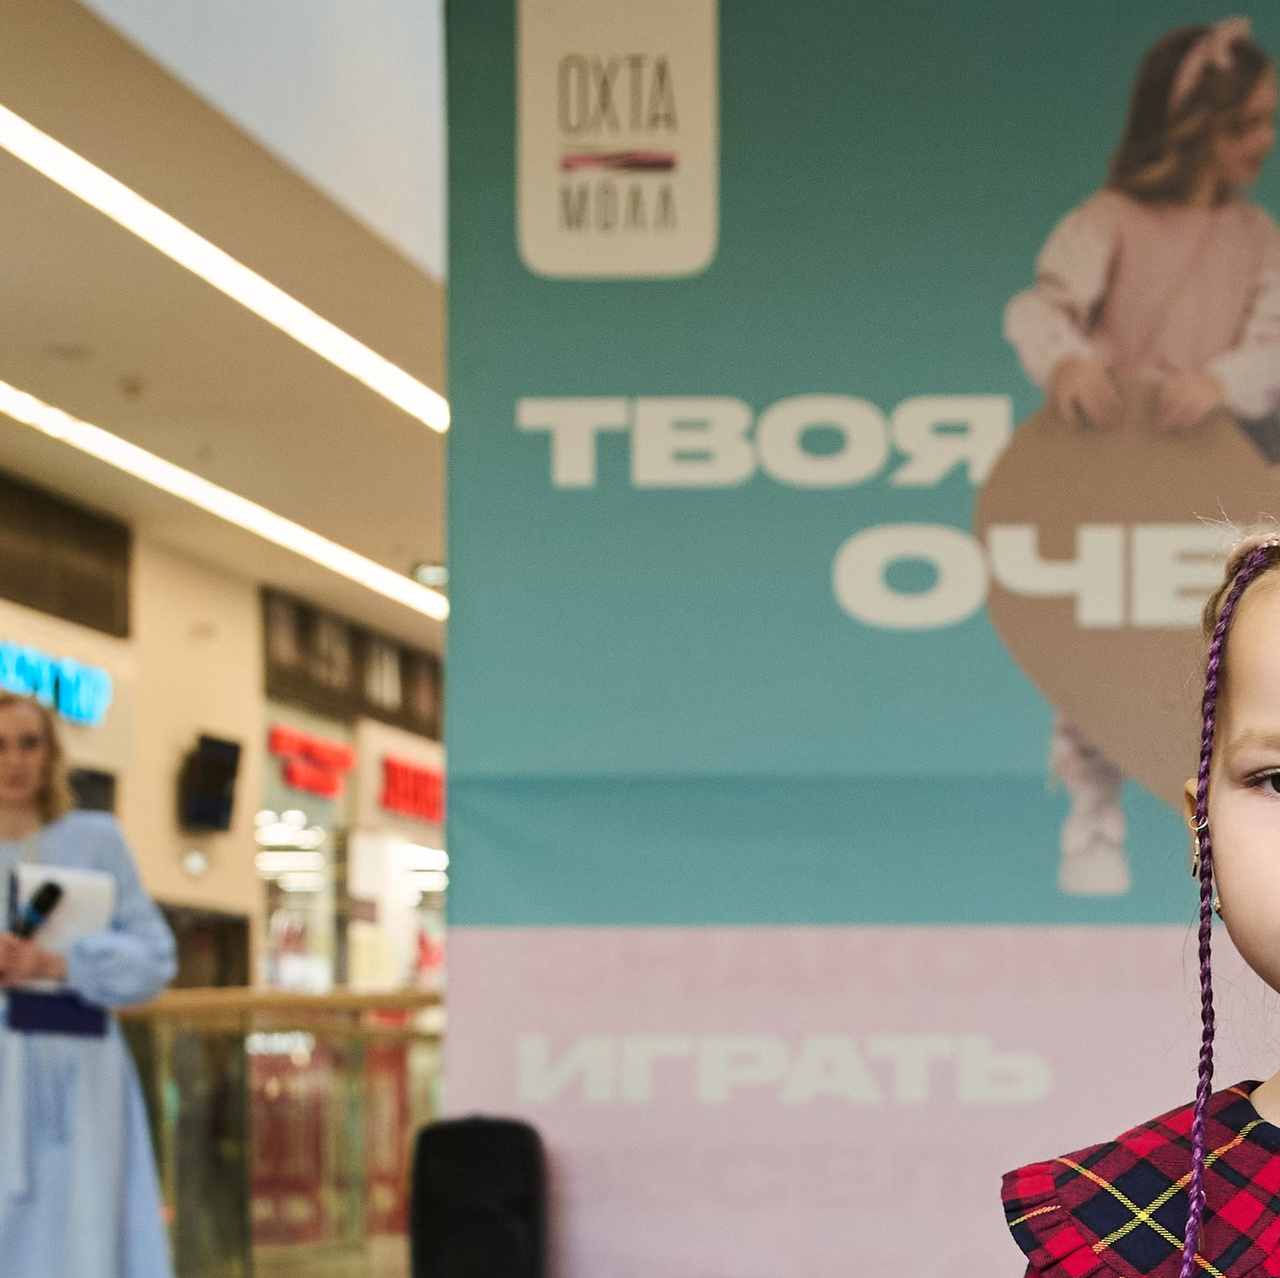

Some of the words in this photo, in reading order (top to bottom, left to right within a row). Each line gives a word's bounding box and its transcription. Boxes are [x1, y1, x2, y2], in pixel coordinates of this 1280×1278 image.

[557, 53, 680, 135] ОХТА
[516, 395, 1012, 488] ТВОЯ
[516, 1032, 1053, 1105] ИГРАТЬ
